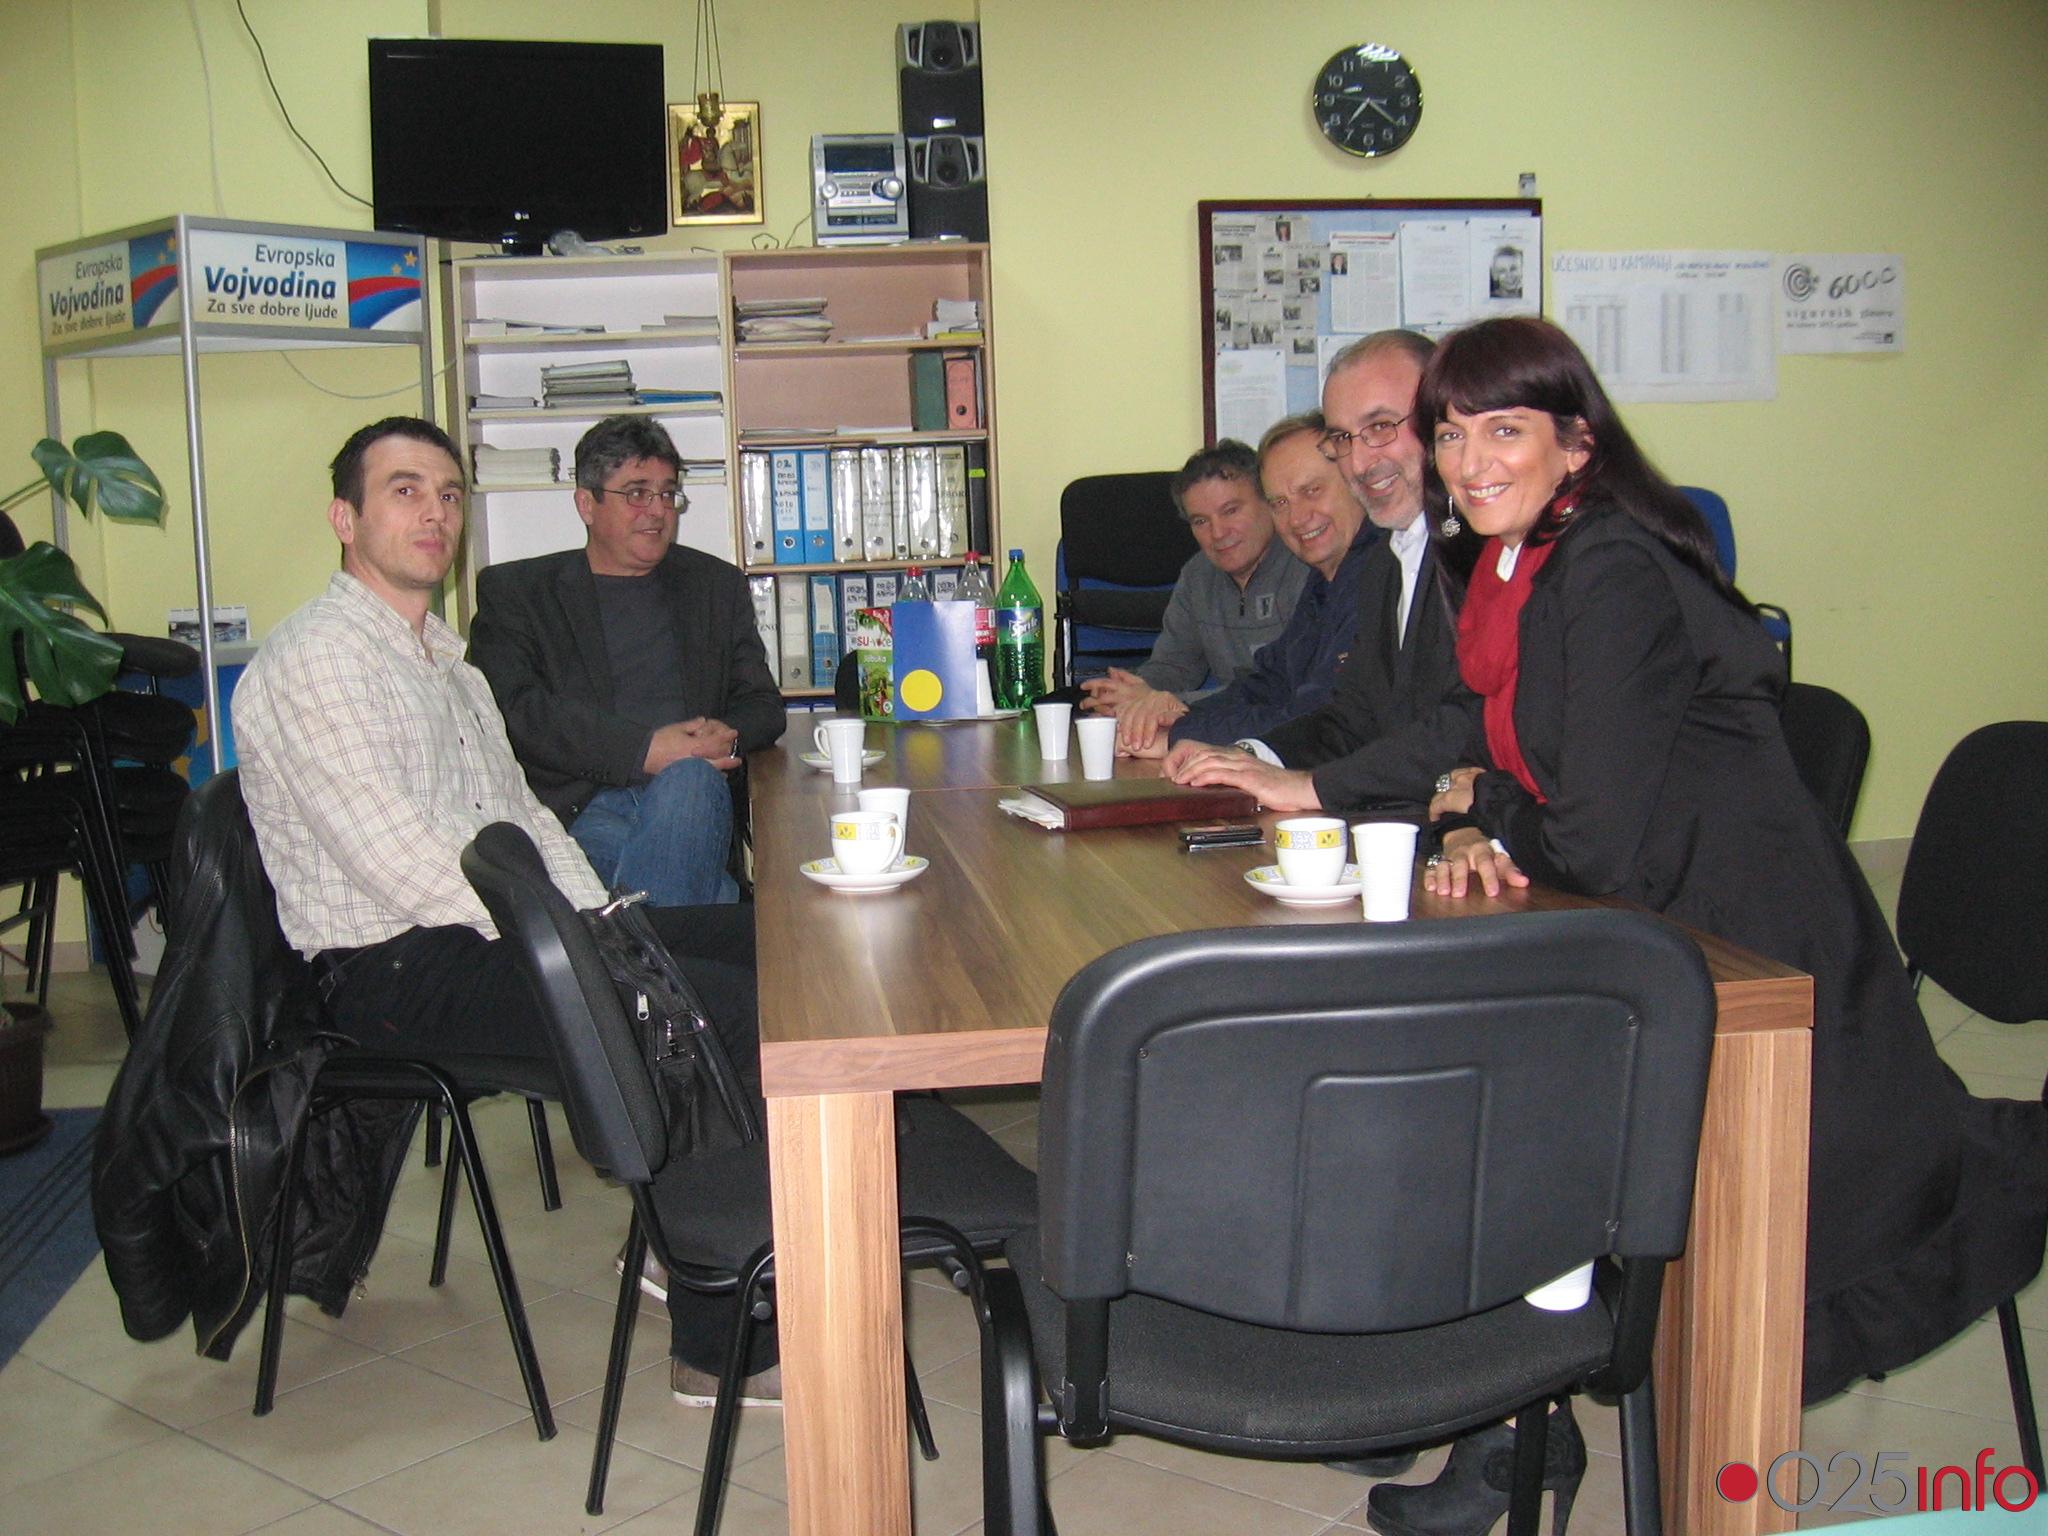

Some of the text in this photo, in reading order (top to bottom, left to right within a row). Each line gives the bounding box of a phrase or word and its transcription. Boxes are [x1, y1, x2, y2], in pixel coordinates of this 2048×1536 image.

[1328, 74, 1343, 87] 10
[76, 254, 123, 279] Evropska
[255, 244, 335, 269] Evropska
[204, 266, 336, 301] Vojvodina
[1829, 266, 1896, 300] 6000
[50, 281, 124, 321] Vojvodina
[207, 299, 338, 321] Za sve dobre ljude
